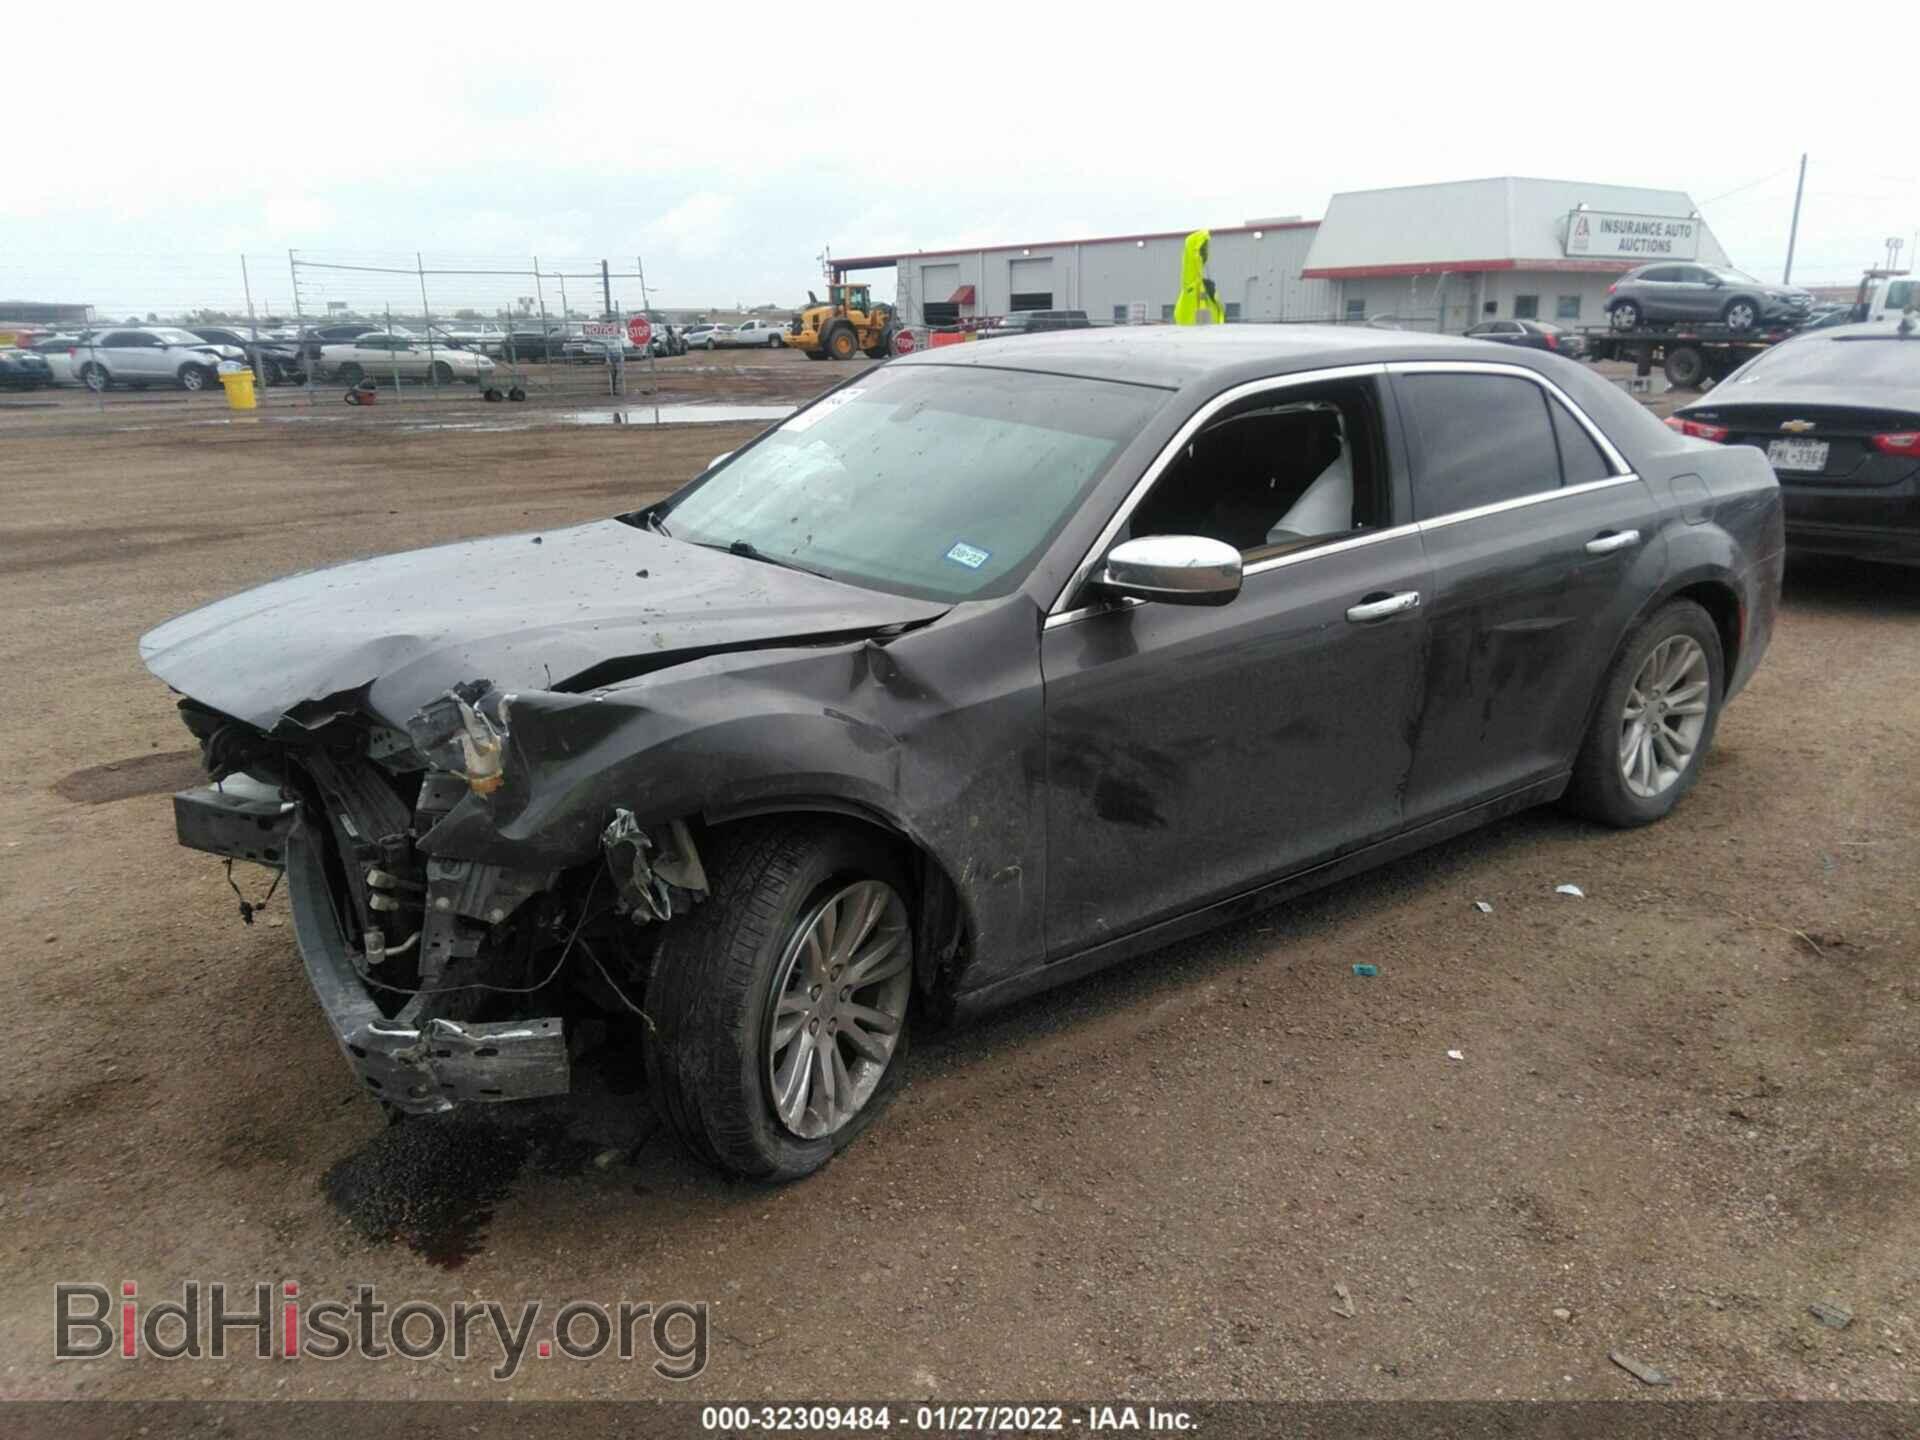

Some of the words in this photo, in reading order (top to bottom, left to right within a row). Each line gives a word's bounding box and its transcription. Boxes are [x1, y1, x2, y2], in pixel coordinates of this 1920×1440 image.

[1600, 218, 1663, 236] INSURANCE
[1665, 224, 1692, 239] AUTO
[1617, 238, 1672, 253] AUCTIONS
[628, 326, 649, 338] STOP
